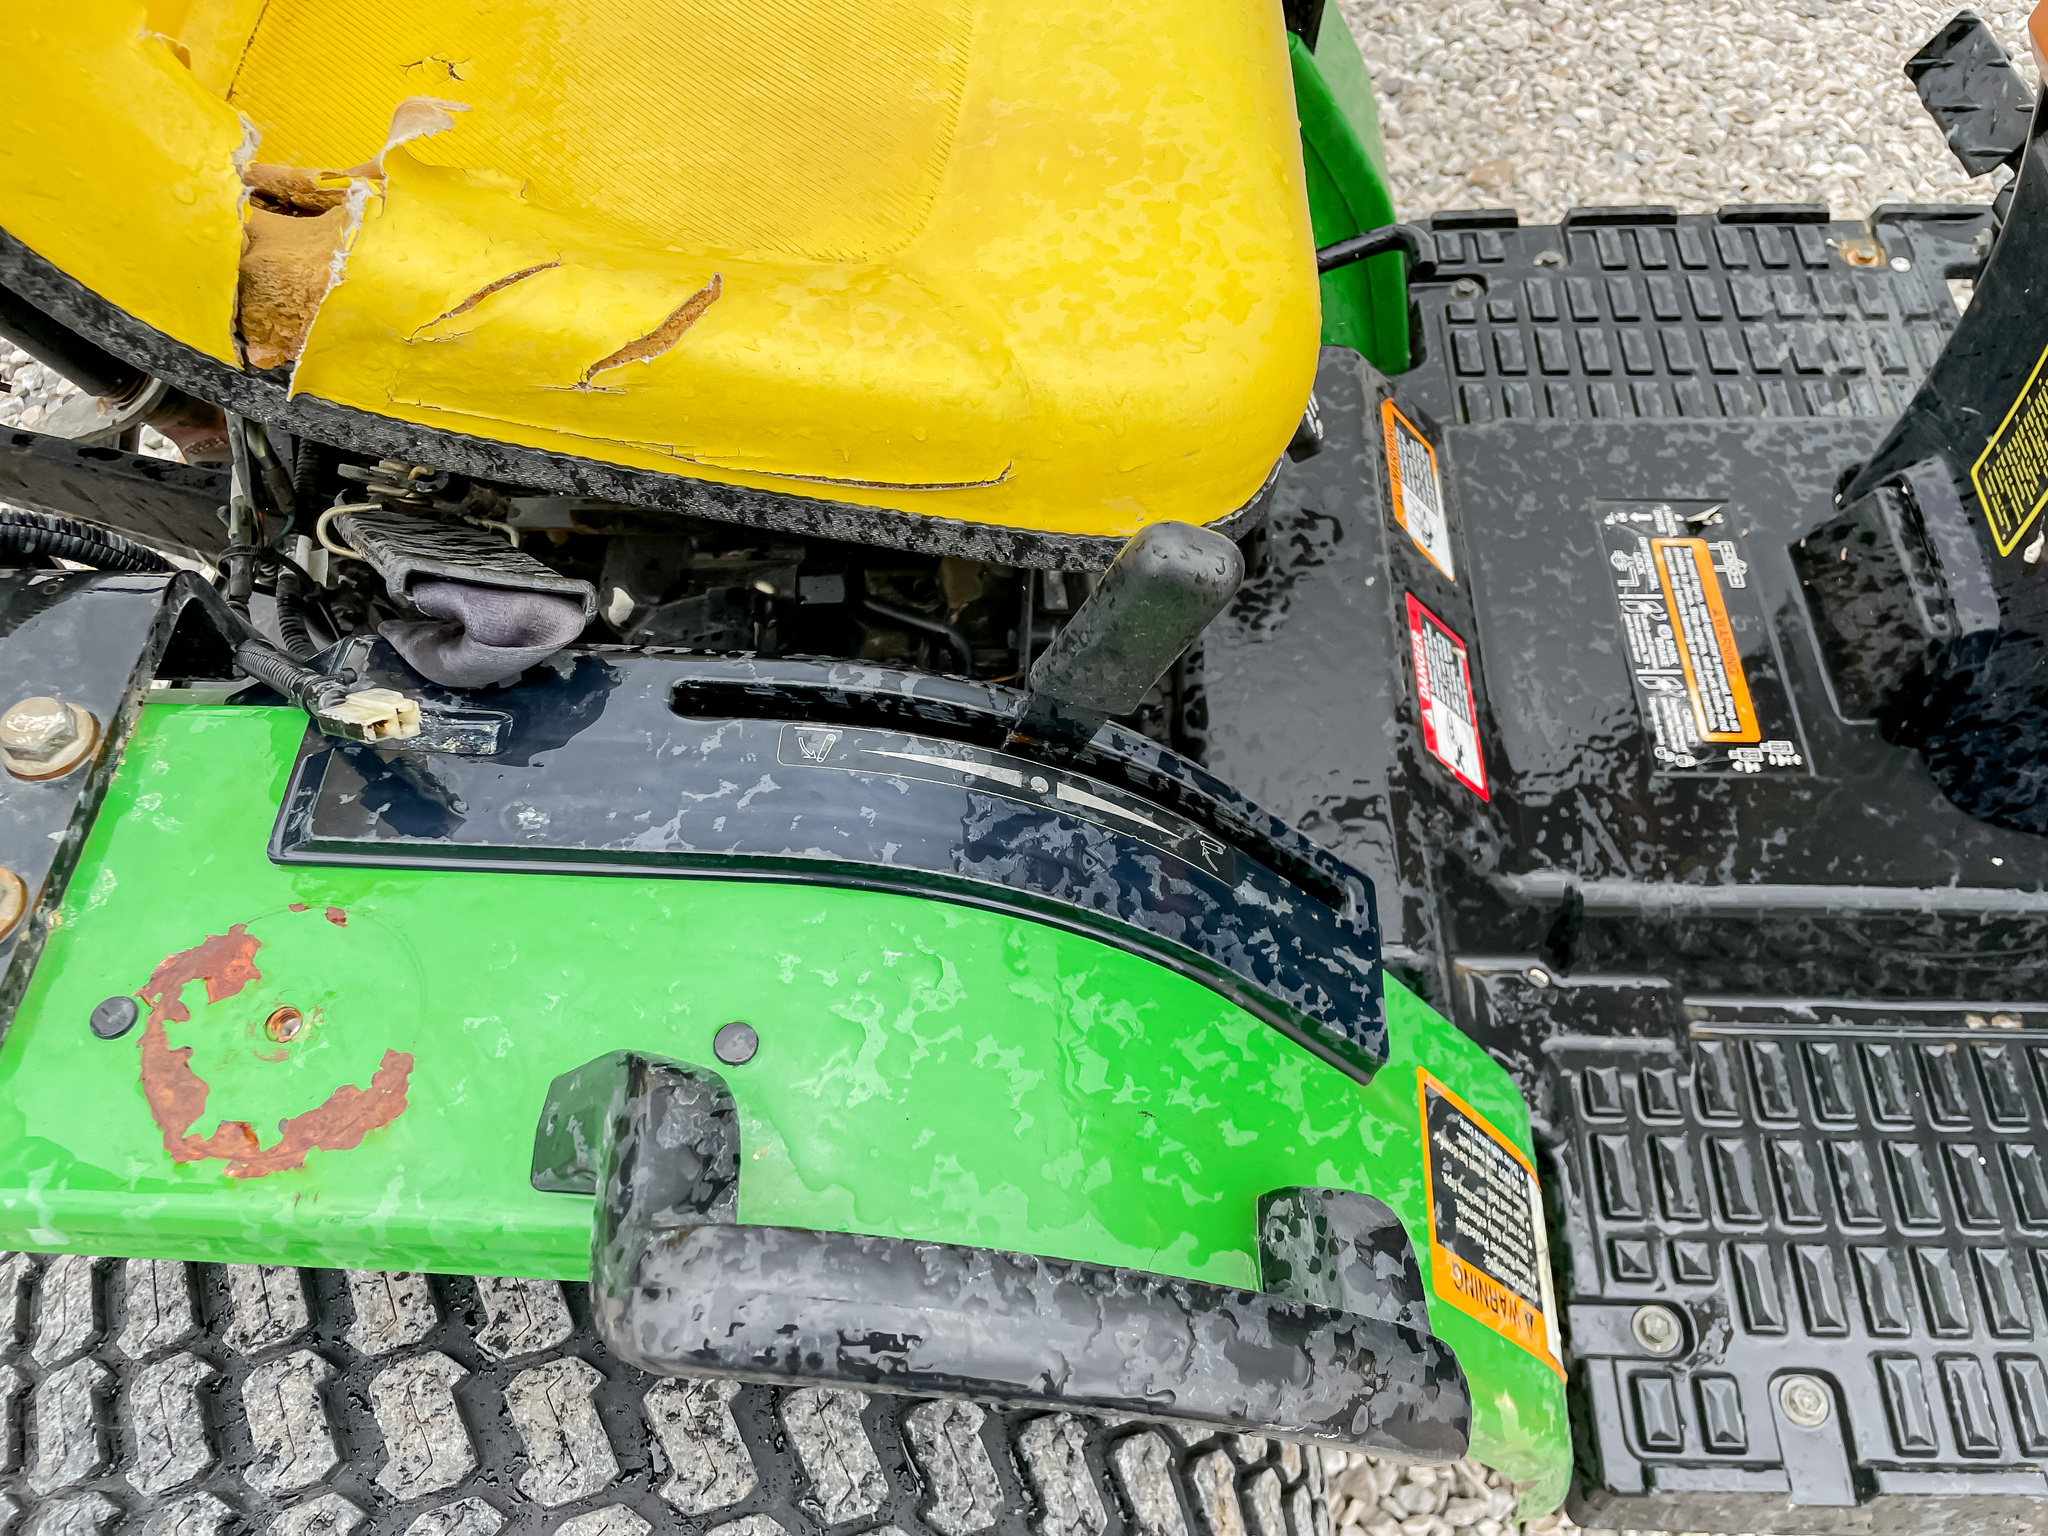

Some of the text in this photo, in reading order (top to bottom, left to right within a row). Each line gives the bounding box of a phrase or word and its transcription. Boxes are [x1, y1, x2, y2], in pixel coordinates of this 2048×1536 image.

[1383, 417, 1402, 487] WARNING
[1633, 552, 1646, 574] LOCK
[1686, 558, 1699, 579] avoid
[1699, 605, 1711, 622] read
[1714, 618, 1739, 675] WARNING
[1410, 626, 1432, 703] DANGER
[1703, 670, 1718, 689] park
[1711, 689, 1724, 713] brake
[1718, 714, 1730, 731] and
[1458, 1116, 1519, 1177] Drive with extra care.
[1459, 1151, 1468, 1167] be
[1457, 1132, 1520, 1194] DO NOT use seat belt.
[1469, 1158, 1485, 1178] must
[1442, 1168, 1457, 1192] tips.
[1486, 1170, 1512, 1199] structure
[1458, 1181, 1485, 1214] machine
[1486, 1188, 1500, 1208] belt.
[1486, 1204, 1491, 1218] if
[1500, 1199, 1512, 1215] seat
[1455, 1199, 1528, 1263] Structure fully extended.
[1456, 1218, 1489, 1250] Protective
[1492, 1207, 1507, 1229] jump
[1508, 1220, 1518, 1235] not
[1451, 1259, 1520, 1328] WARNING
